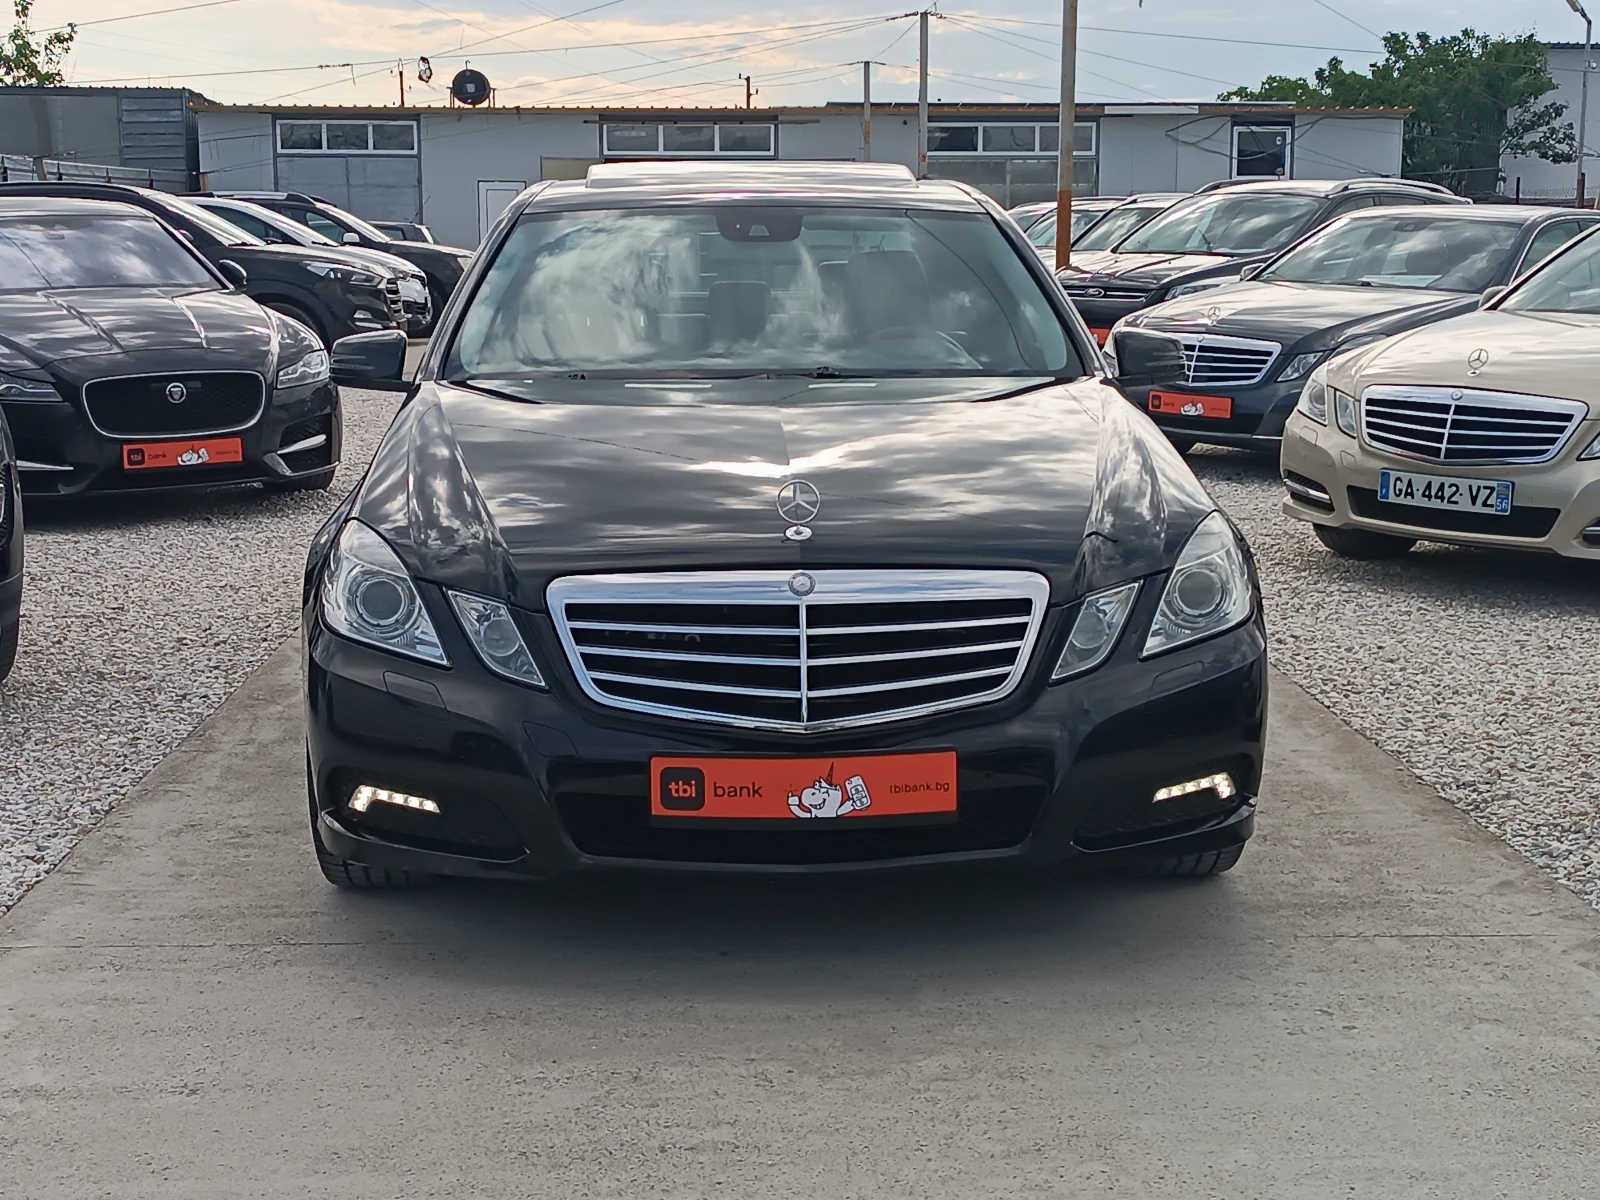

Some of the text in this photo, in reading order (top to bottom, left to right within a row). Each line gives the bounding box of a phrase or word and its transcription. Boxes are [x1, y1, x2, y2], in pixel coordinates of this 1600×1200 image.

[1496, 499, 1509, 510] 56
[668, 780, 763, 798] tbi bank
[889, 781, 950, 794] tbibank.bg
